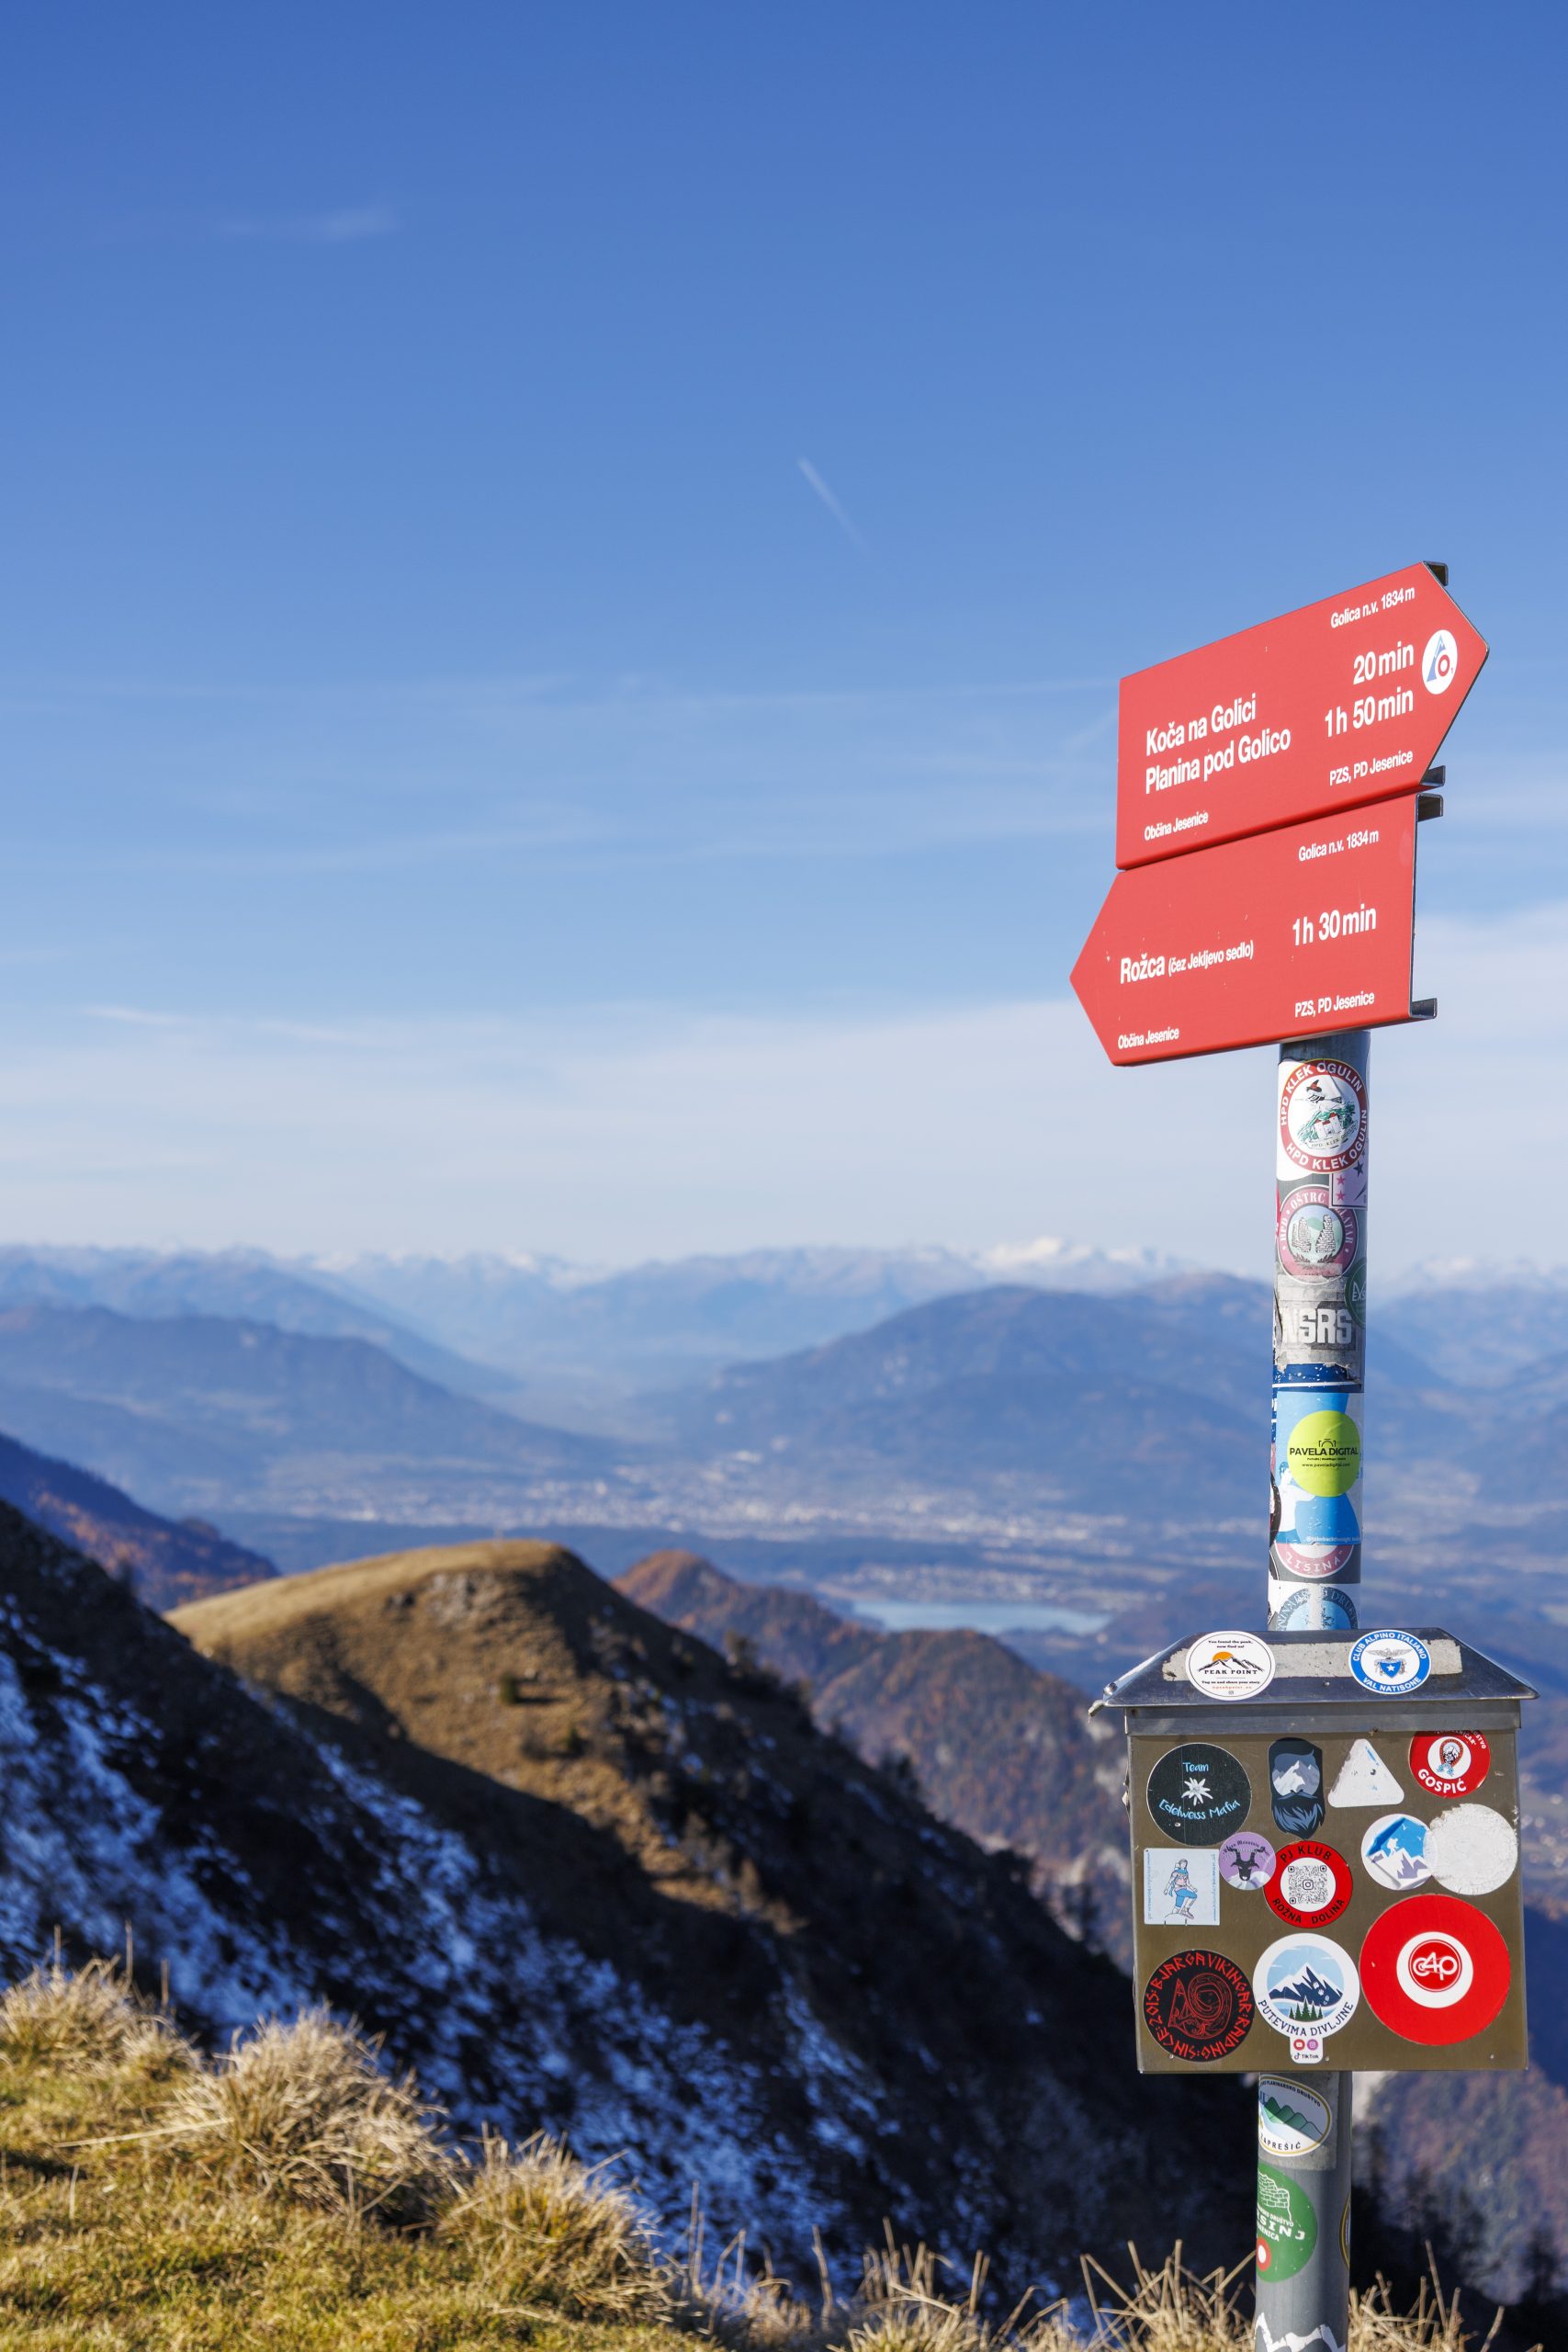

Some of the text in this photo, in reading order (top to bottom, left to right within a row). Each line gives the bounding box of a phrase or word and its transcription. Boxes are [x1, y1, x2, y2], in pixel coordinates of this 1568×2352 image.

[1331, 607, 1360, 628] Golica
[1362, 601, 1379, 617] n.v.
[1146, 692, 1256, 757] Koča na Golici
[1145, 728, 1292, 795] Planina pod Golico
[1329, 750, 1414, 786] PZS, PD Jesenice
[1144, 811, 1209, 841] Občina Jesenice
[1298, 842, 1327, 862] Golica
[1328, 839, 1345, 854] n.v.
[1120, 939, 1254, 985] Rožca (čez Jekljevo sedlo)
[1294, 990, 1375, 1018] PZS, PD Jesenice
[1117, 1026, 1179, 1049] Občina Jesenice
[1280, 1062, 1363, 1125] HPD KLEK OGULIN
[1286, 1142, 1309, 1166] HPD
[1312, 1155, 1349, 1170] KLEK
[1348, 1109, 1368, 1159] OGULIN
[1289, 1446, 1359, 1456] PAVELA DIGITAL
[1352, 1632, 1427, 1661] CLUB ALPINO ITALIANO
[1362, 1676, 1422, 1692] VAL NATISONE
[1182, 1761, 1210, 1772] Team
[1417, 1769, 1467, 1793] GOSPIĆ
[1158, 1799, 1241, 1820] Edelweiss Mafia
[1280, 1845, 1332, 1863] PJ KLUB
[1272, 1898, 1345, 1925] ROŽNA DOLINA
[1258, 1999, 1354, 2037] PUTEVIMA DIVLJINE
